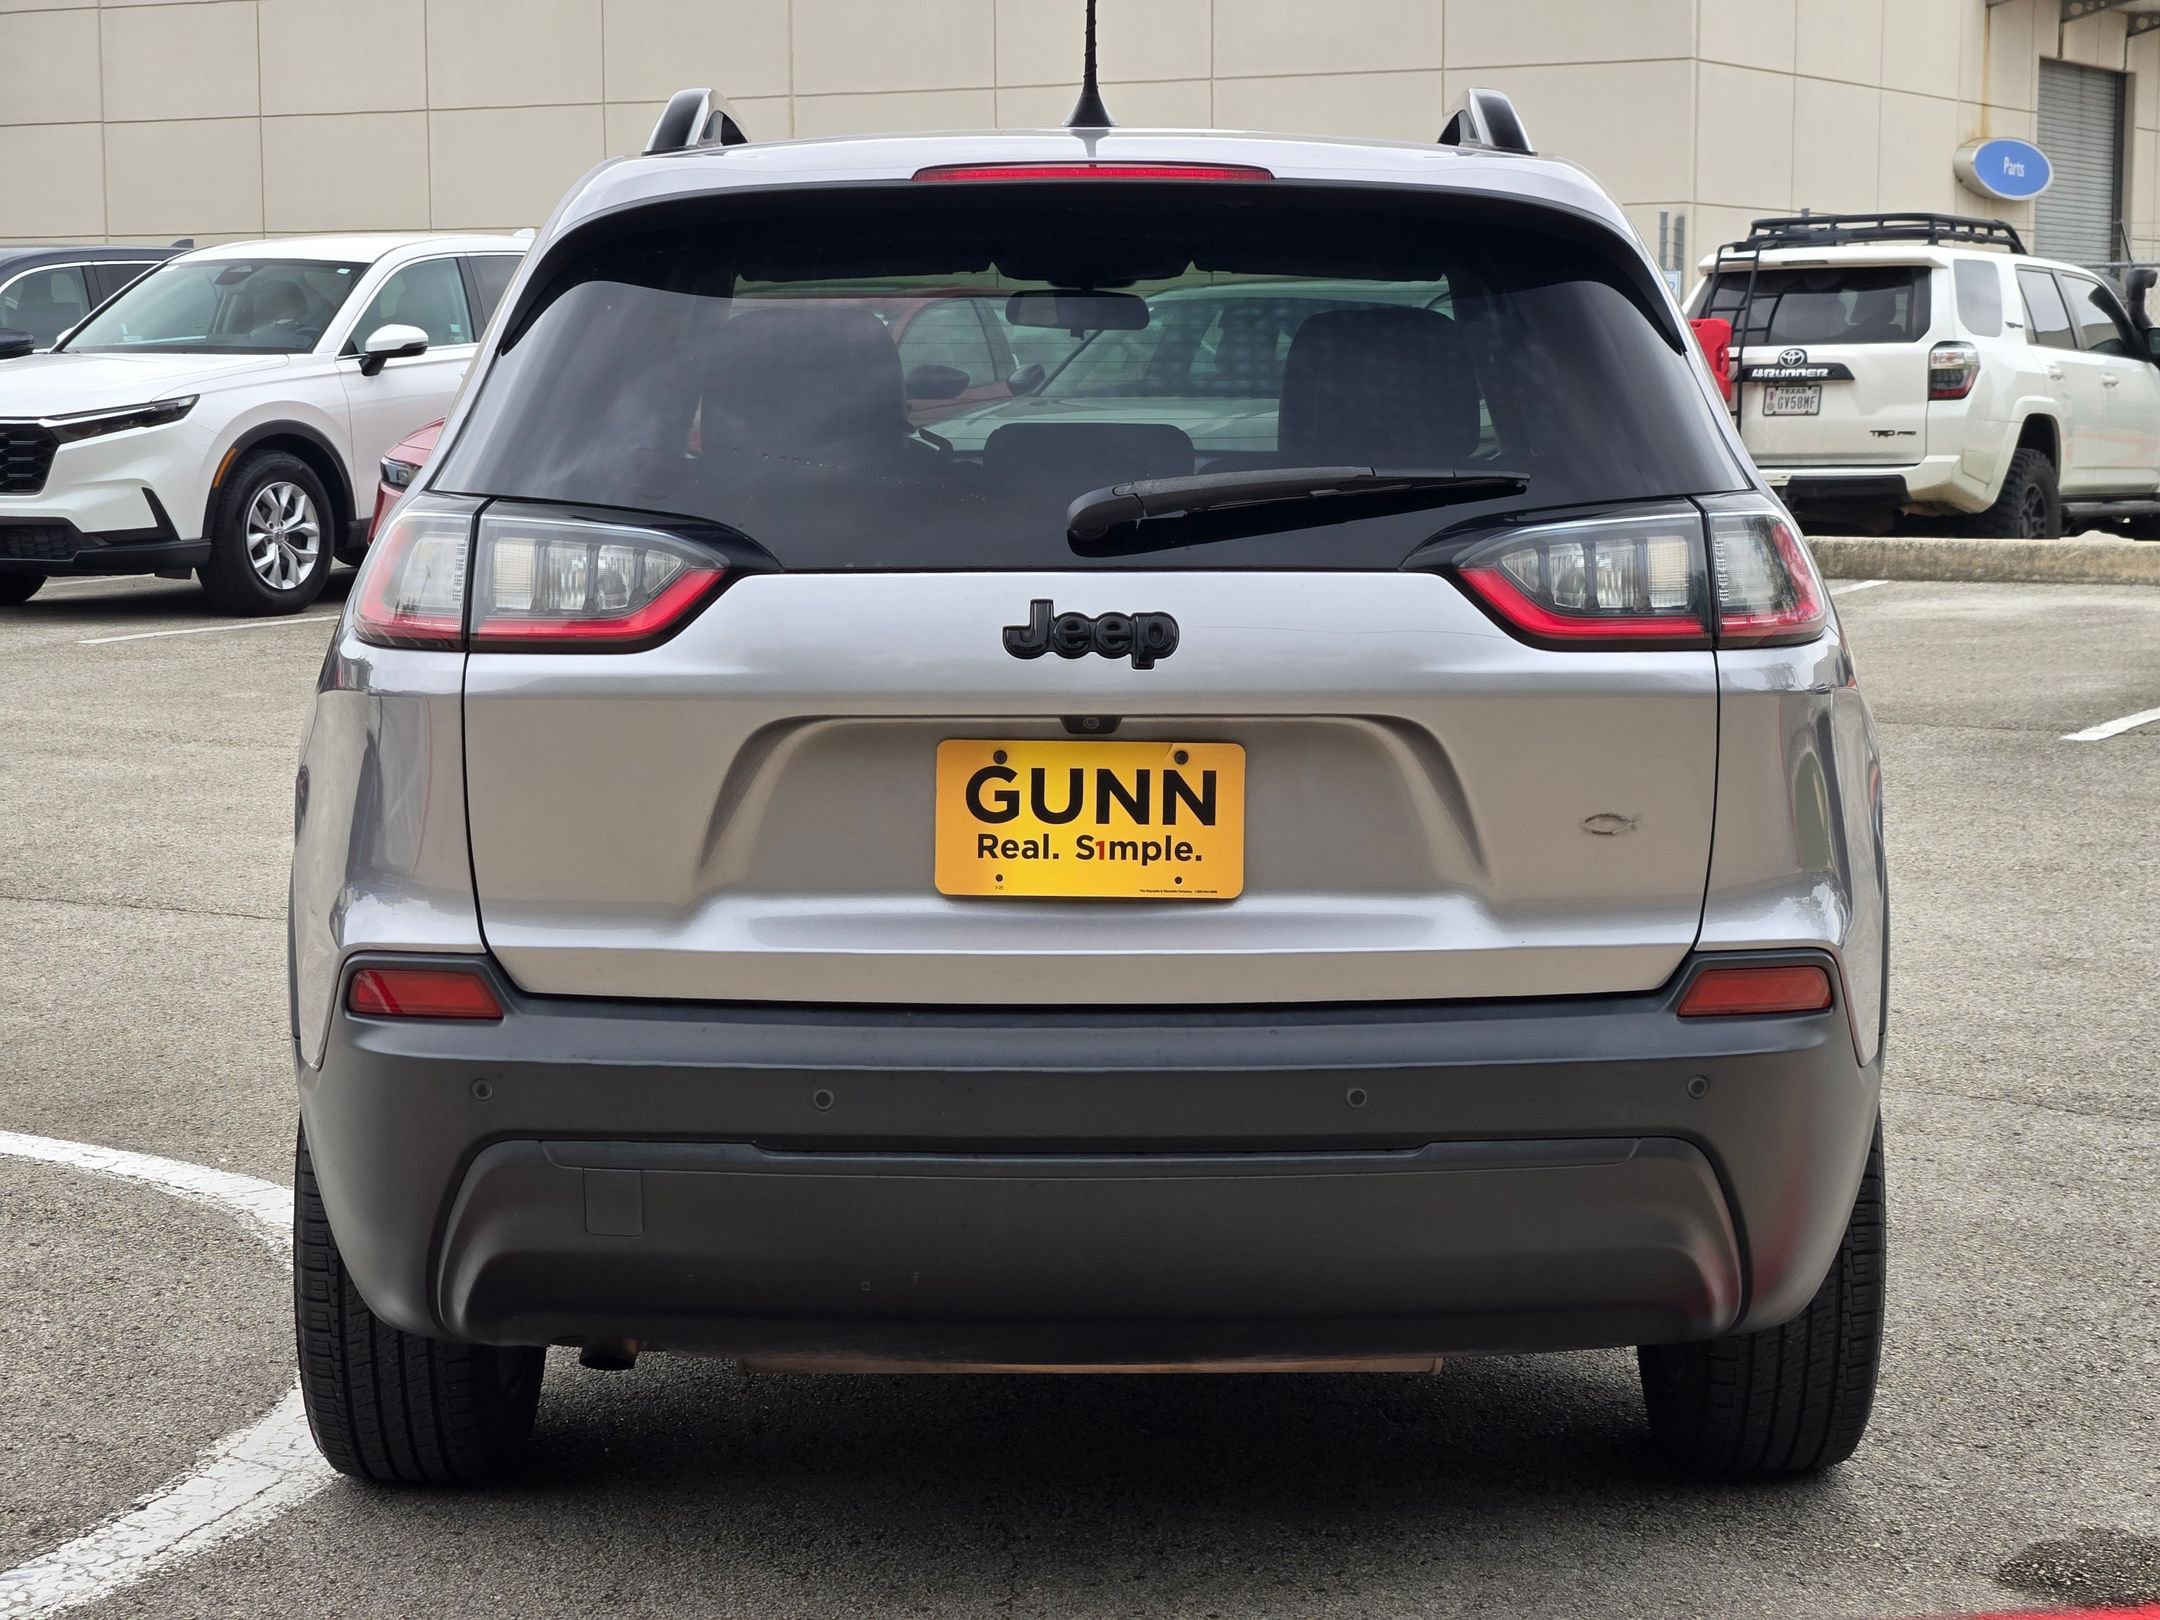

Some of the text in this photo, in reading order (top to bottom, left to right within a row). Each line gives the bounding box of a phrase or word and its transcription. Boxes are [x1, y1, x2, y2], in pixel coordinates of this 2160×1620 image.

[2003, 156, 2025, 177] Parts
[1752, 368, 1829, 377] 4RUNNER
[1003, 599, 1179, 669] Jeep
[965, 765, 1217, 826] GUNN
[977, 833, 1060, 860] Real.
